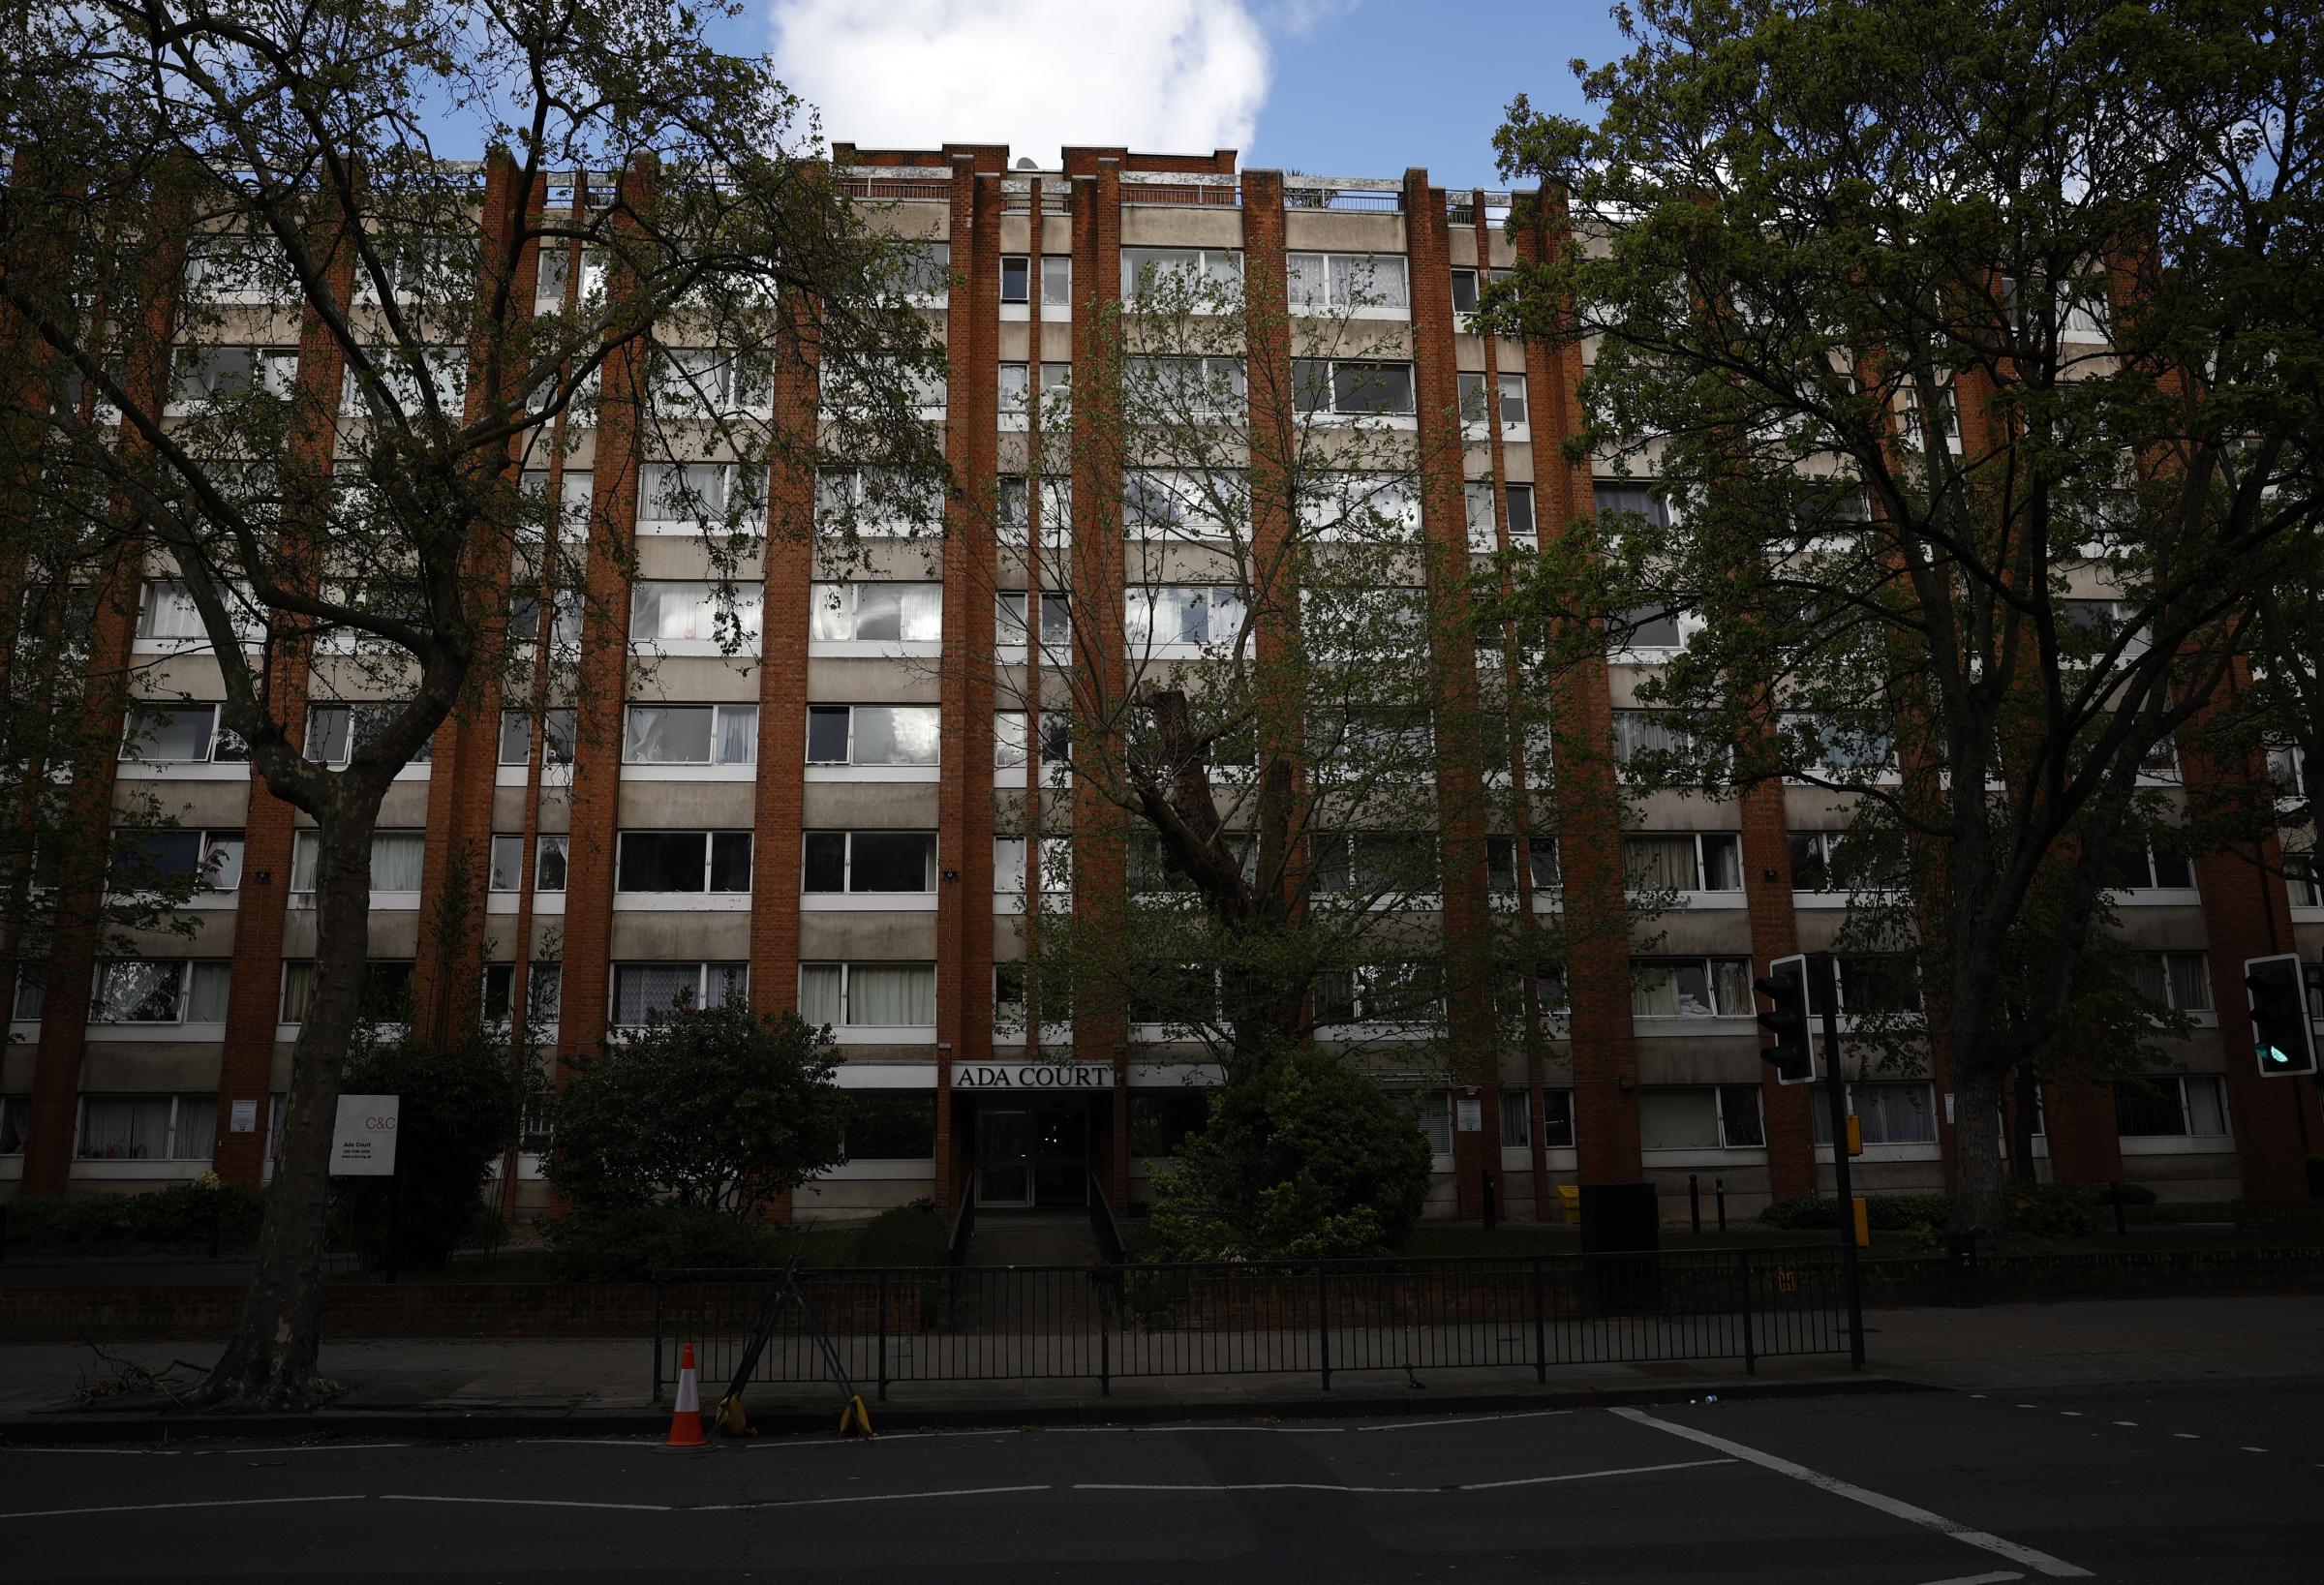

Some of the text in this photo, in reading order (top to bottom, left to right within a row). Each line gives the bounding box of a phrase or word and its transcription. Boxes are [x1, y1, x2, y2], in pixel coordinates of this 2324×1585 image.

[958, 1067, 1108, 1086] ADA COURT
[365, 1116, 396, 1130] C&C
